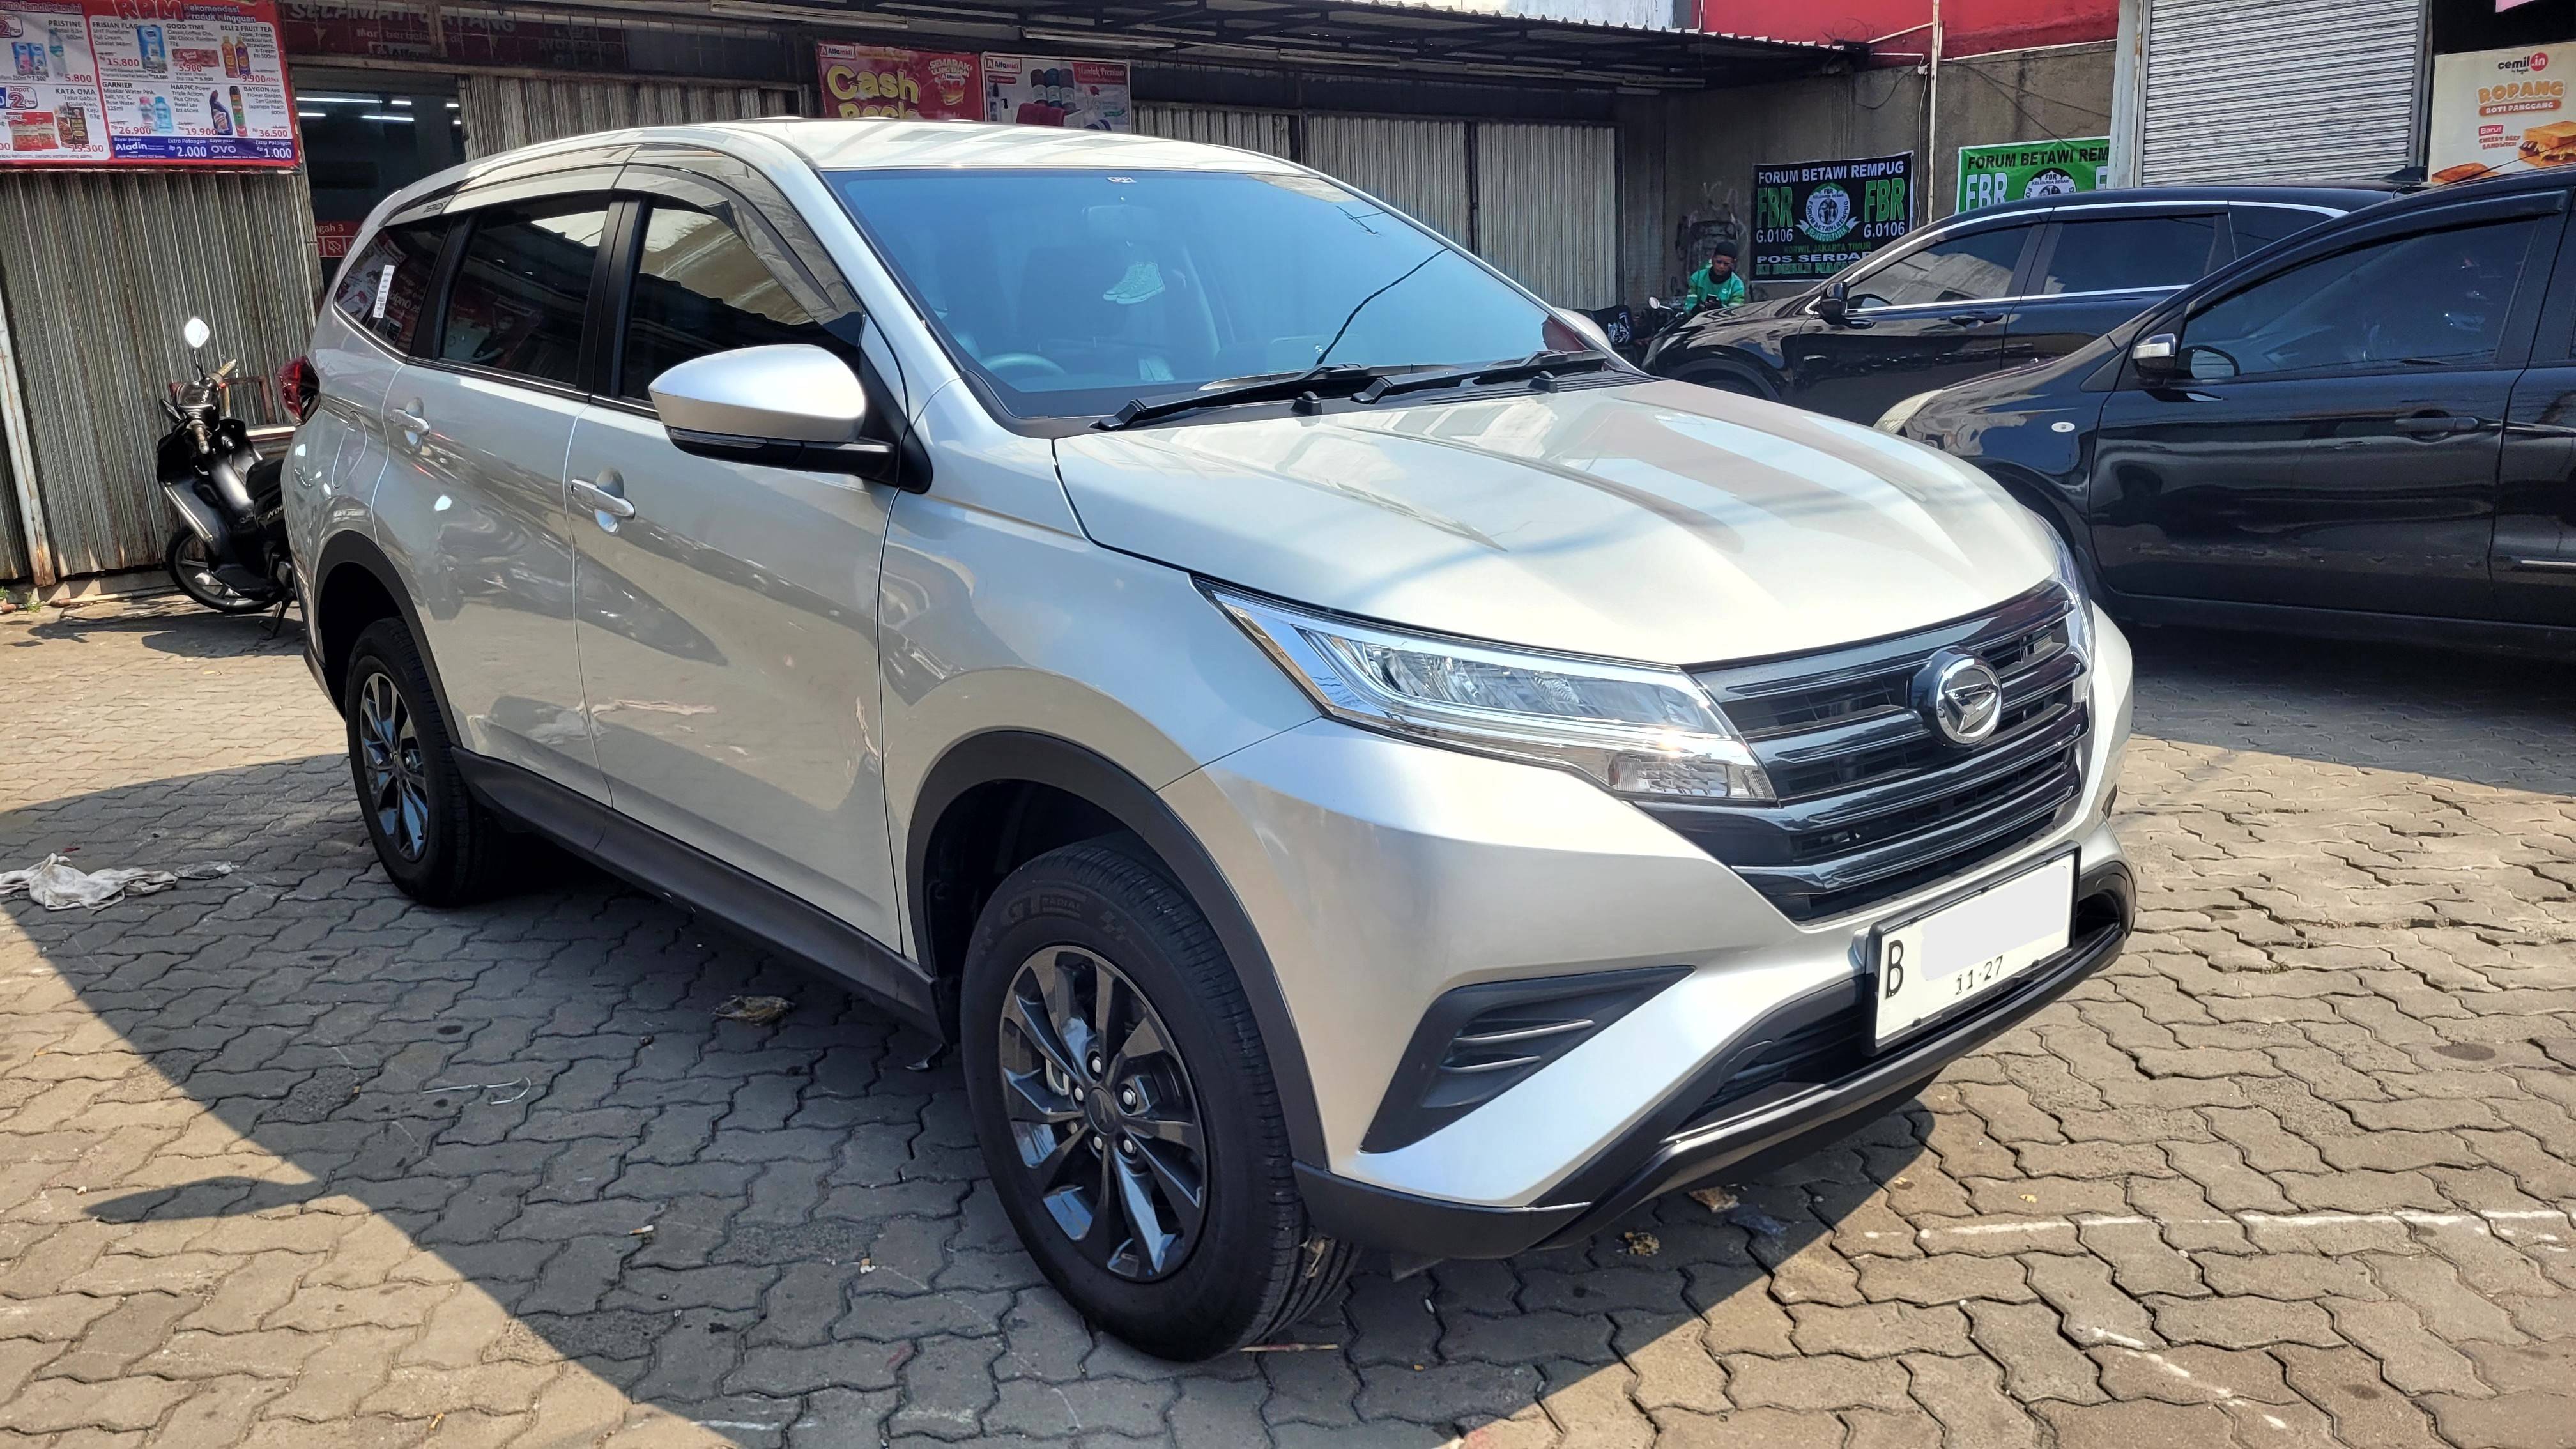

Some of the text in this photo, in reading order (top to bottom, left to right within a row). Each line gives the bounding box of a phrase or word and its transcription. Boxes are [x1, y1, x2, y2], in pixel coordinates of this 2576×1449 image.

[112, 0, 185, 21] RPM
[183, 4, 240, 13] Rekomendasi
[186, 13, 256, 24] Produk Mingguan
[107, 57, 139, 66] 15.800
[994, 61, 1019, 70] Alfamidi
[65, 74, 92, 82] 5.800
[827, 65, 920, 103] Cash
[2478, 80, 2564, 105] ROPANG
[8, 92, 26, 109] 2
[2486, 102, 2554, 114] ROTI PANGGANG
[116, 142, 148, 151] Aladin
[176, 146, 207, 157] 2.000
[211, 145, 236, 153] OVO
[263, 148, 292, 158] 1.000
[1968, 146, 2109, 170] FORUM BETAWI REM
[1758, 160, 1904, 185] FORUM BETAWI REMPUG
[1966, 172, 2008, 211] FBR
[1864, 178, 1906, 223] FBR
[1757, 187, 1793, 228] FBR
[1807, 200, 1849, 231] FORUM BETAWI REMPUG
[339, 224, 344, 233] 3
[1864, 221, 1906, 238] G.0106
[1756, 229, 1793, 243] G.0106
[1812, 243, 1846, 253] JAKARTA
[1848, 241, 1871, 250] TIMUR
[1757, 256, 1793, 264] POS
[1885, 940, 1905, 999] B
